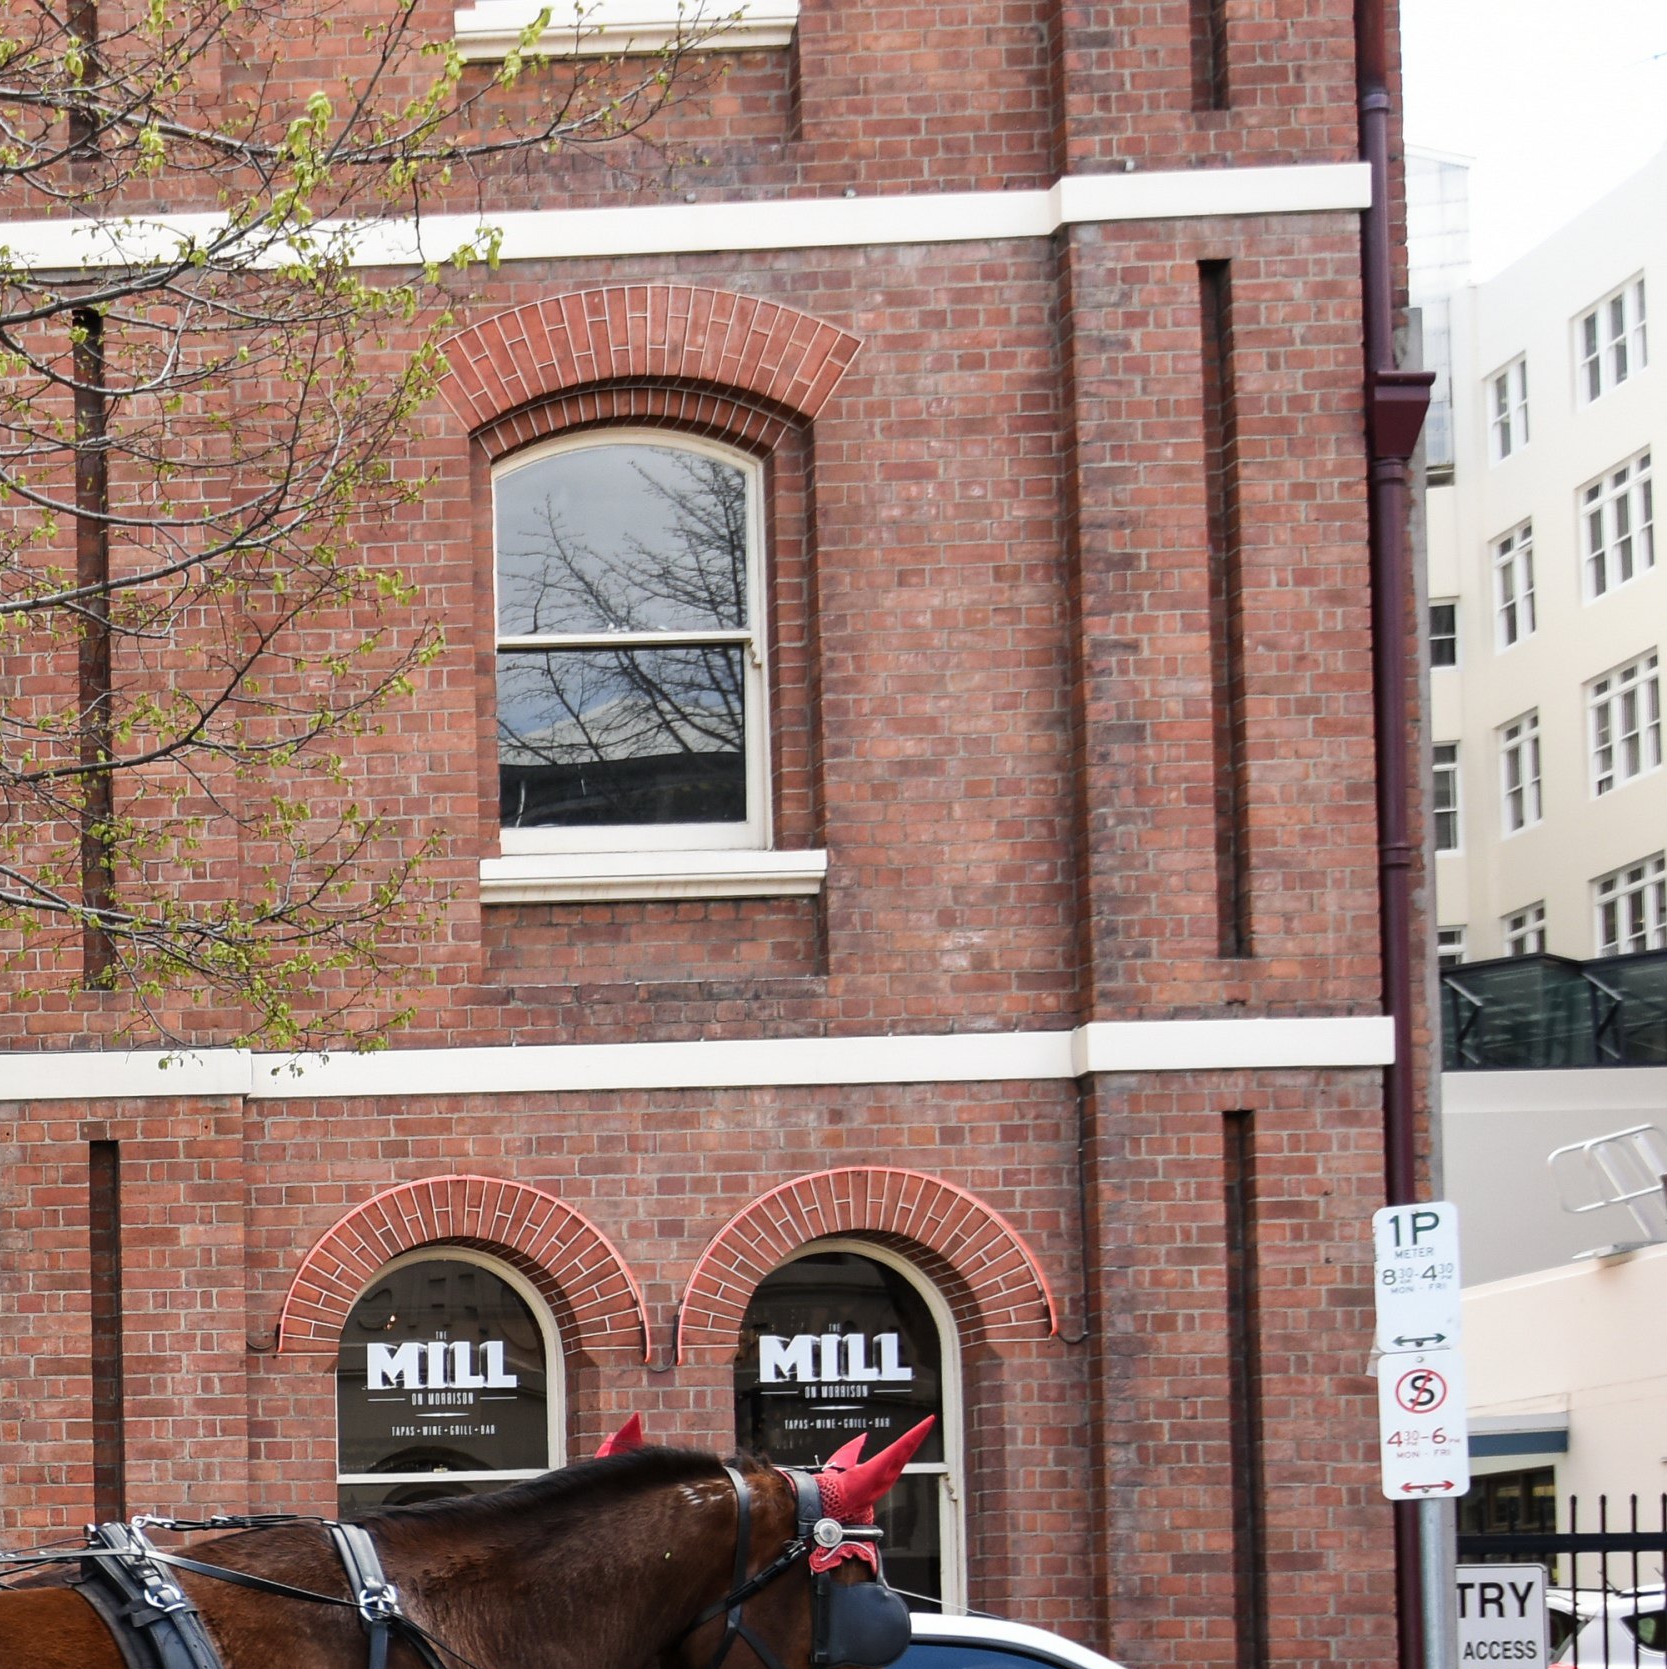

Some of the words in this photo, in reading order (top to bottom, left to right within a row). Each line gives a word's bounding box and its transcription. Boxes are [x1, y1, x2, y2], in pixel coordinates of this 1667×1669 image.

[1394, 1247, 1435, 1260] METER
[1390, 1286, 1415, 1295] MON
[759, 1333, 913, 1383] MILL
[367, 1341, 518, 1390] MILL
[411, 1393, 423, 1406] ON
[427, 1392, 474, 1405] MORRISON
[804, 1386, 817, 1399] ON
[821, 1385, 868, 1398] MORRISON
[784, 1419, 809, 1430] TAPAS
[843, 1418, 867, 1428] GRILL
[874, 1417, 890, 1428] BAR
[391, 1426, 415, 1437] TAPAS
[449, 1425, 472, 1436] GRILL
[480, 1425, 495, 1435] BAR
[1396, 1451, 1420, 1460] MON
[1456, 1581, 1535, 1619] TRY
[1463, 1640, 1538, 1660] ACCESS
